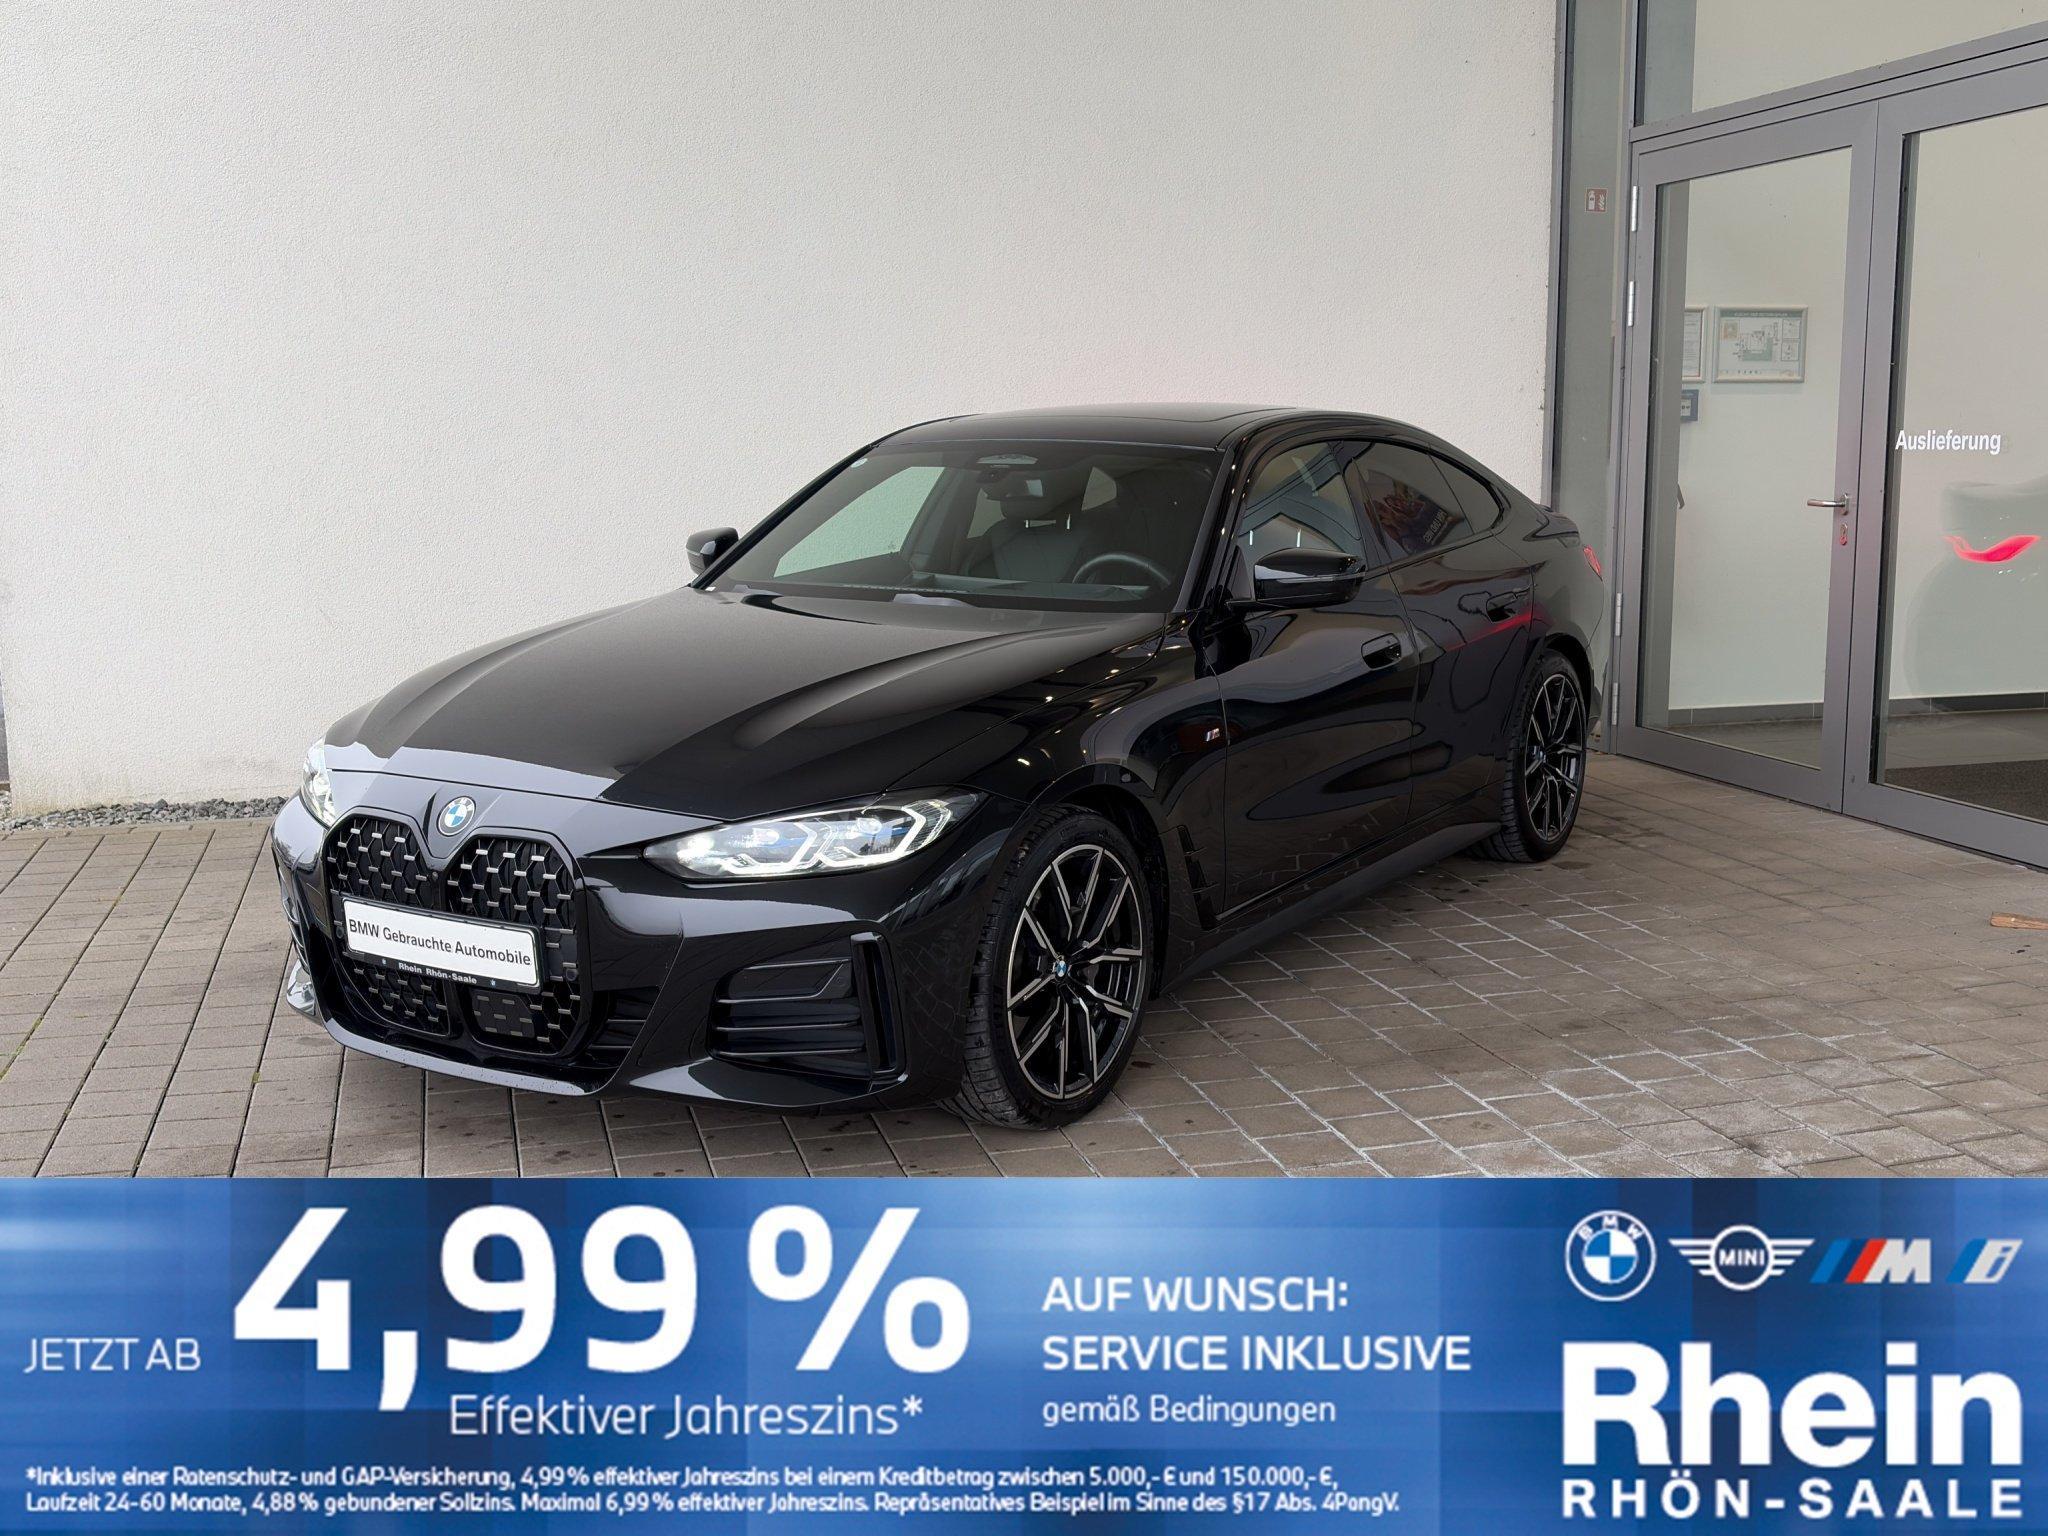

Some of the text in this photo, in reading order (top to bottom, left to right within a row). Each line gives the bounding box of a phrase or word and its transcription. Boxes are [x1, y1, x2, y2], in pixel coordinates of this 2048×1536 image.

[1895, 429, 2001, 455] Auslieferung
[349, 918, 531, 966] BMW Gebrauchte Automobile
[398, 962, 422, 974] Rhein
